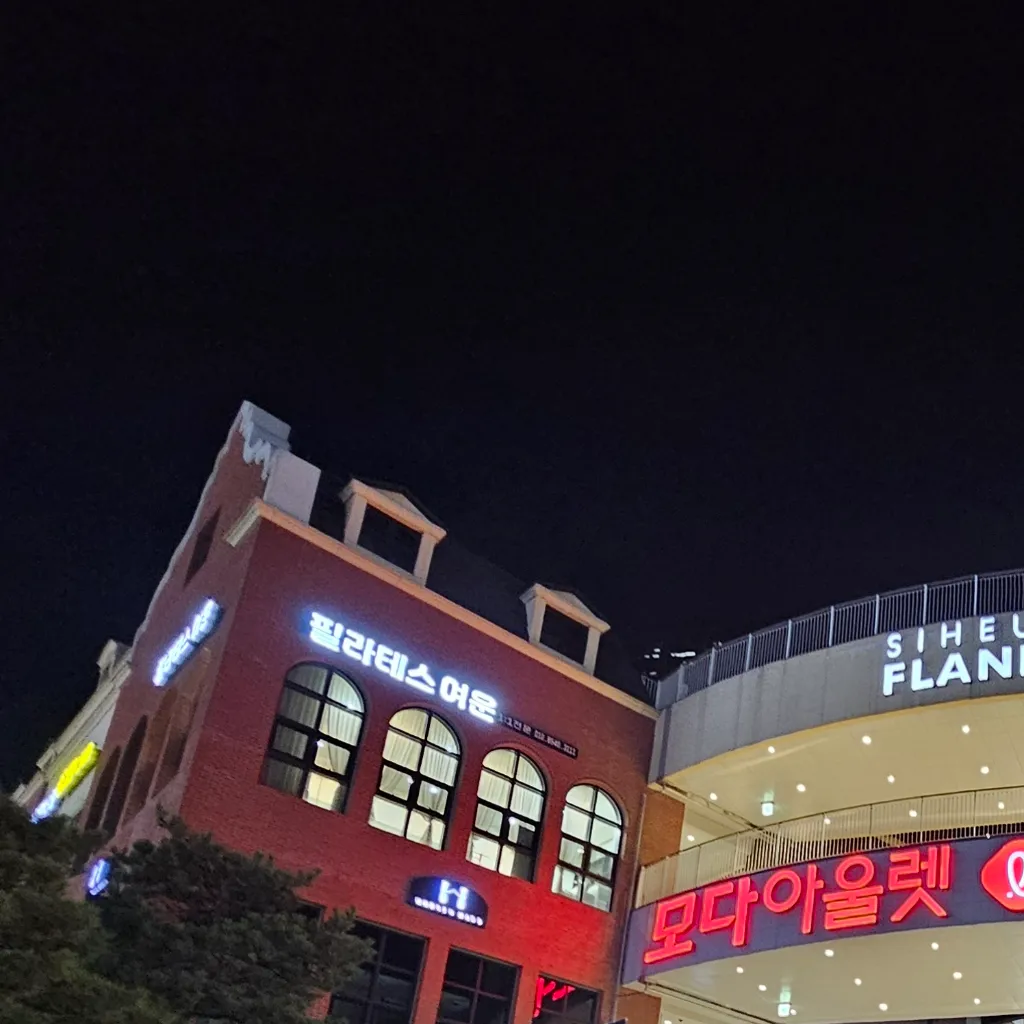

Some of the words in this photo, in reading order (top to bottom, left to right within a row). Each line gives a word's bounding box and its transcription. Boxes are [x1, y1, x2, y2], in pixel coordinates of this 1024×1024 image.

[309, 610, 436, 695] 필라테스
[438, 673, 498, 724] 여운
[642, 842, 953, 965] 모다아울렛
